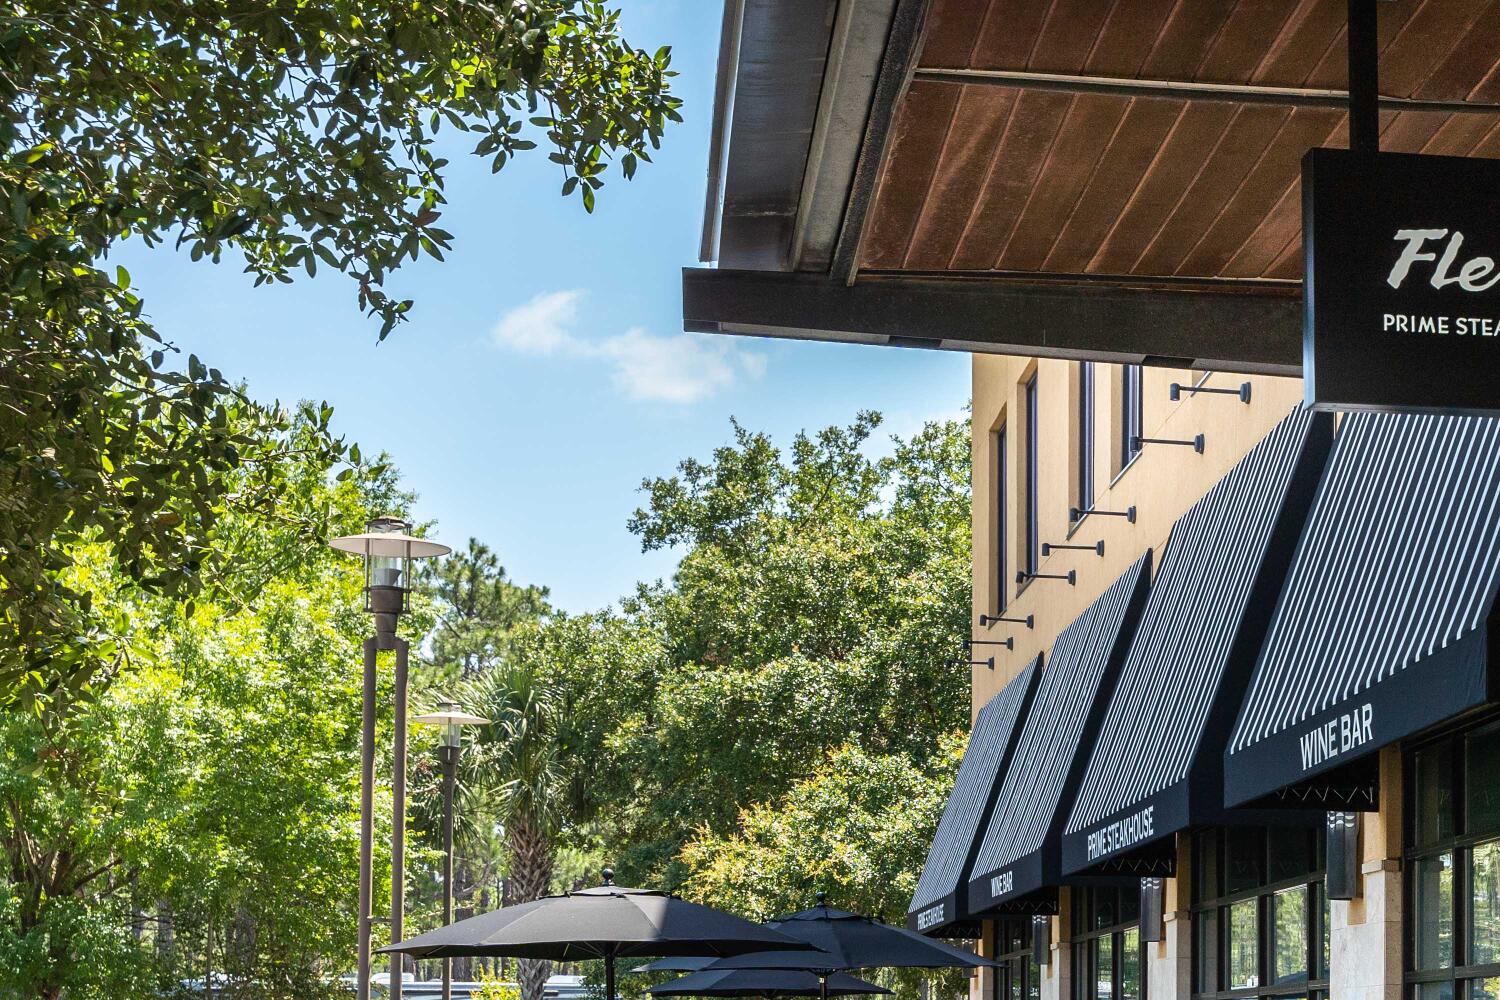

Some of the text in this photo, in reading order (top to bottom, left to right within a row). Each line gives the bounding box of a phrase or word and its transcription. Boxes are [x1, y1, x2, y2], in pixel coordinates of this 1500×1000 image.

[1383, 313, 1449, 335] PRIME
[1300, 703, 1373, 770] WINE BAR
[1088, 805, 1154, 861] PRIME STEAKHOUSE
[1002, 870, 1013, 893] BAR
